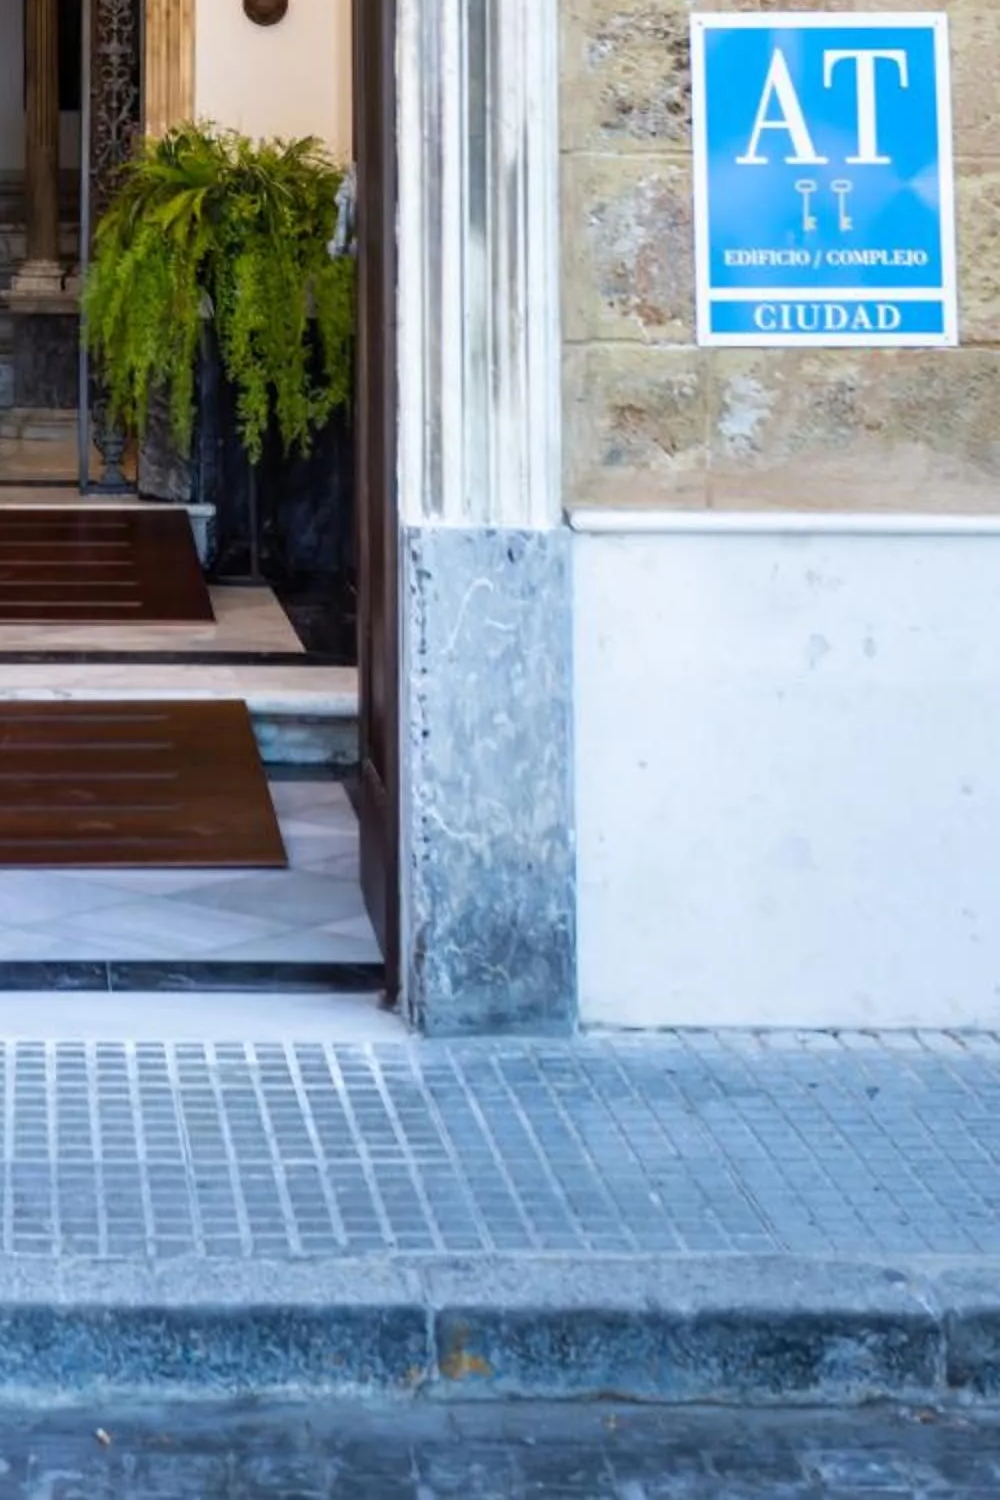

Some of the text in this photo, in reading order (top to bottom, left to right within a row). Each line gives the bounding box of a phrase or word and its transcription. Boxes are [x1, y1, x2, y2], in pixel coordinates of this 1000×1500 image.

[735, 48, 909, 165] AT
[724, 249, 810, 267] EDIFICIO
[826, 249, 928, 267] COMPLEJO
[753, 302, 902, 330] CIUDAD
